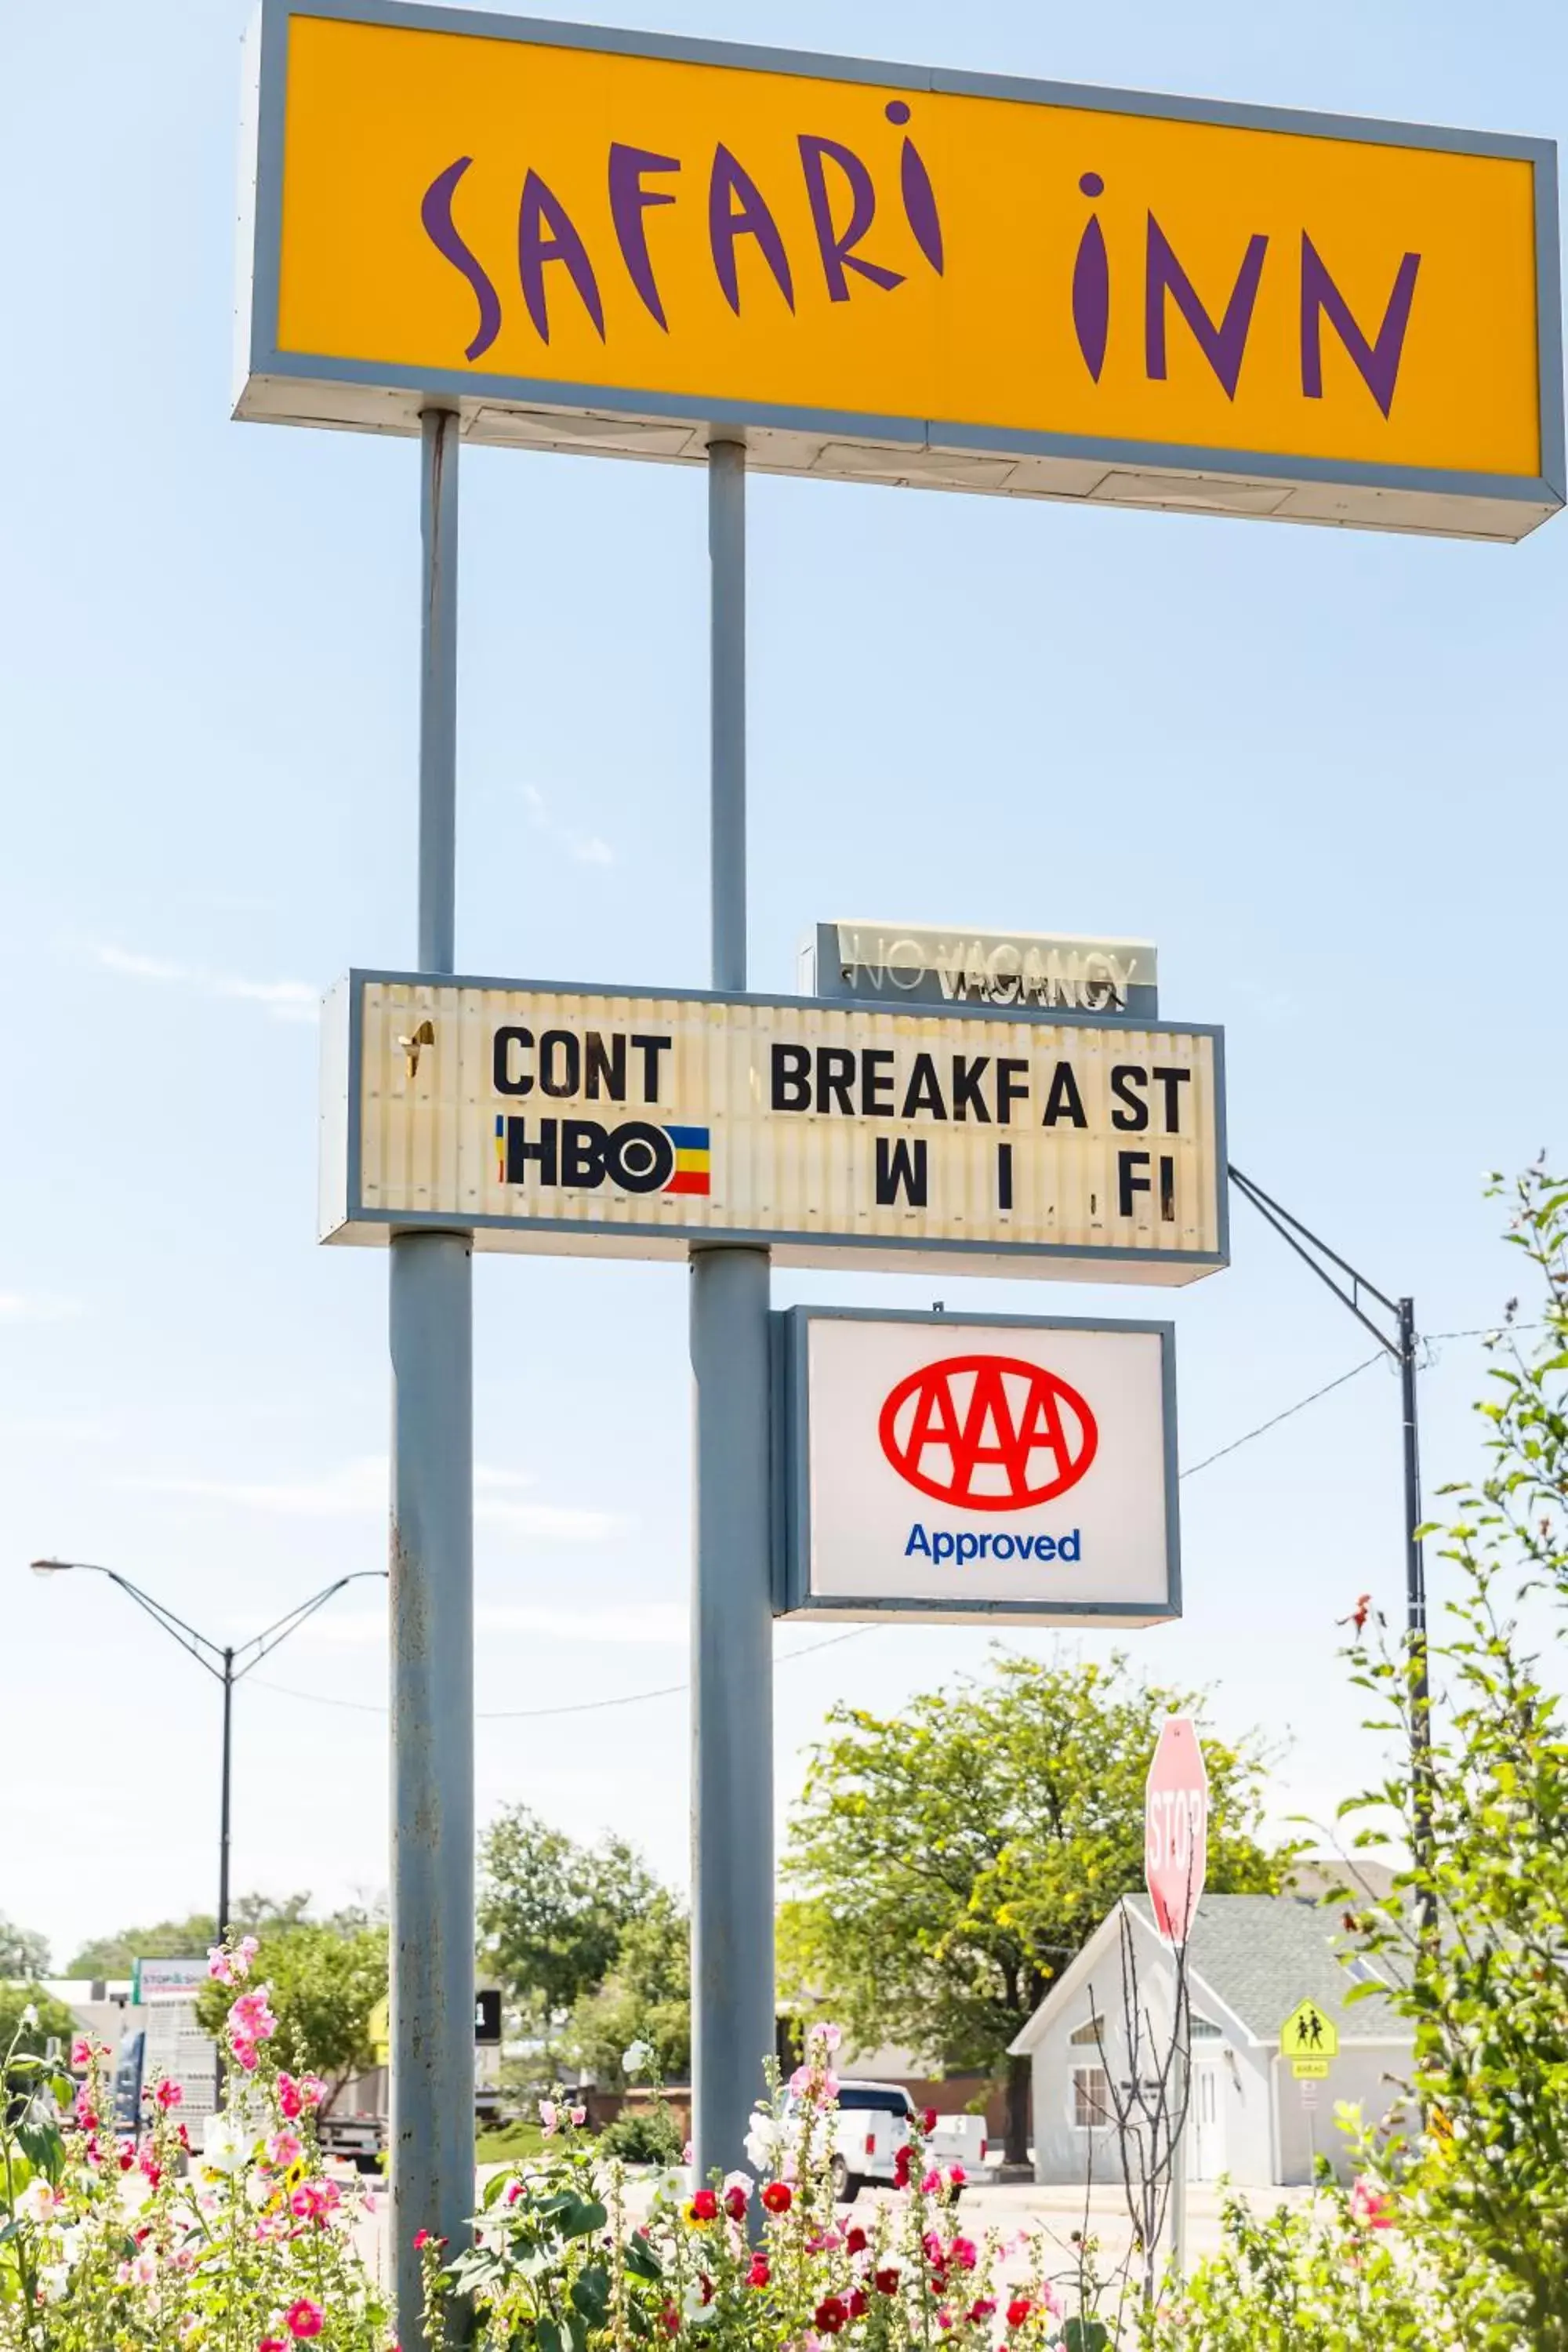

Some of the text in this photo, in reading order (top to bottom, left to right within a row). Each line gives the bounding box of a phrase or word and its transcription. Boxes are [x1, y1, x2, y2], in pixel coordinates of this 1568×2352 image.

[842, 933, 1137, 1013] NO VACANCY
[493, 1025, 672, 1103] CONT
[506, 1115, 673, 1193] HBO
[879, 1355, 1098, 1512] AAA
[905, 1523, 1082, 1566] Approved
[1149, 1788, 1202, 1871] STOP
